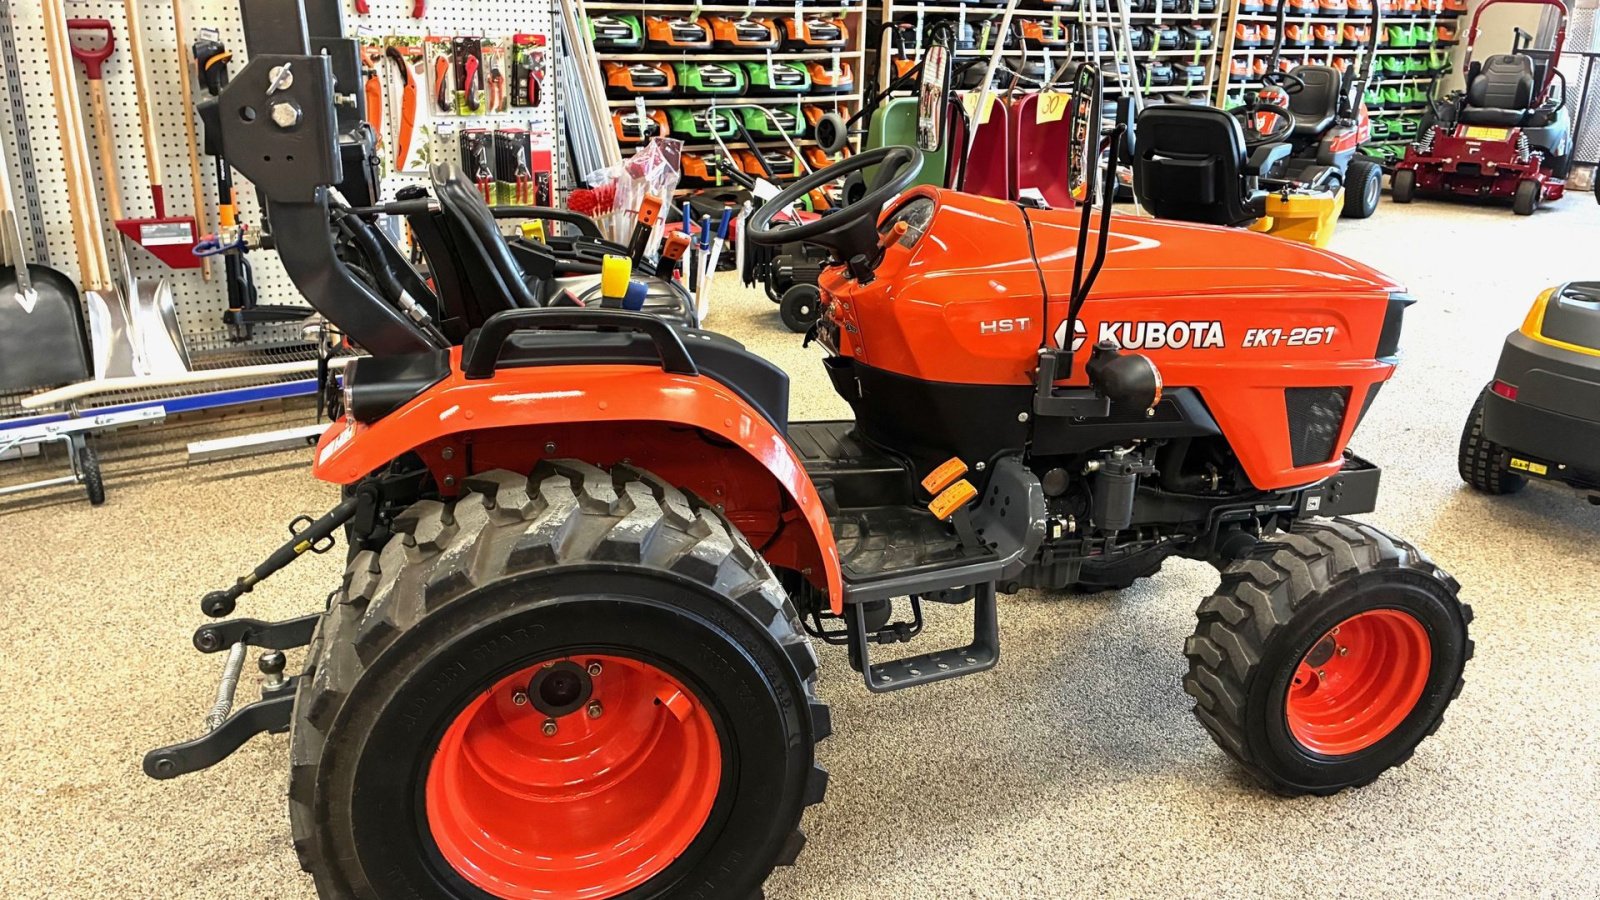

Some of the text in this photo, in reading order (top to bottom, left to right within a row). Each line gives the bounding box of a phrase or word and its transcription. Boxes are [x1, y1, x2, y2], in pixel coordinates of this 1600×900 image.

[1041, 95, 1060, 115] 30
[980, 317, 1030, 334] HST
[1098, 320, 1336, 350] KUBOTA EK1-261
